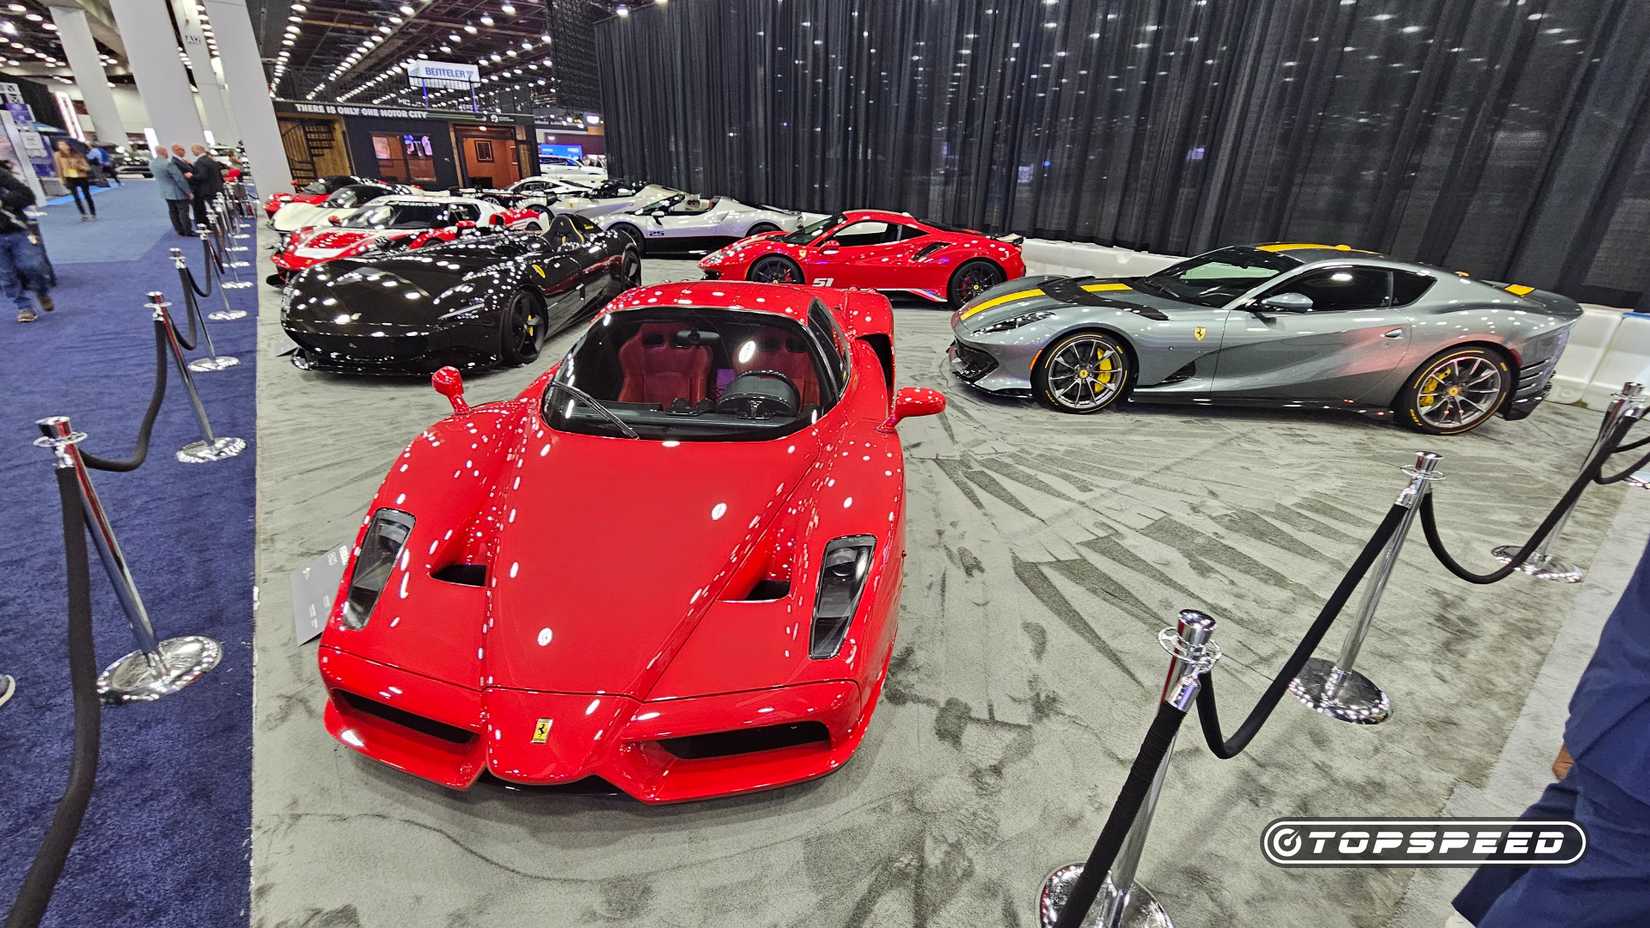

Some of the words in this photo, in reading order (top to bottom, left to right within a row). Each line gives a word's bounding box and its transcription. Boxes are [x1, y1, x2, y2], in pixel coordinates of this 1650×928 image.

[425, 66, 466, 78] BENTELER
[294, 103, 325, 114] THERE
[326, 105, 337, 115] IS
[337, 106, 360, 116] ONLY
[360, 107, 379, 117] ONE
[380, 108, 408, 119] MOTOR
[408, 110, 428, 119] CITY
[812, 277, 834, 287] 51
